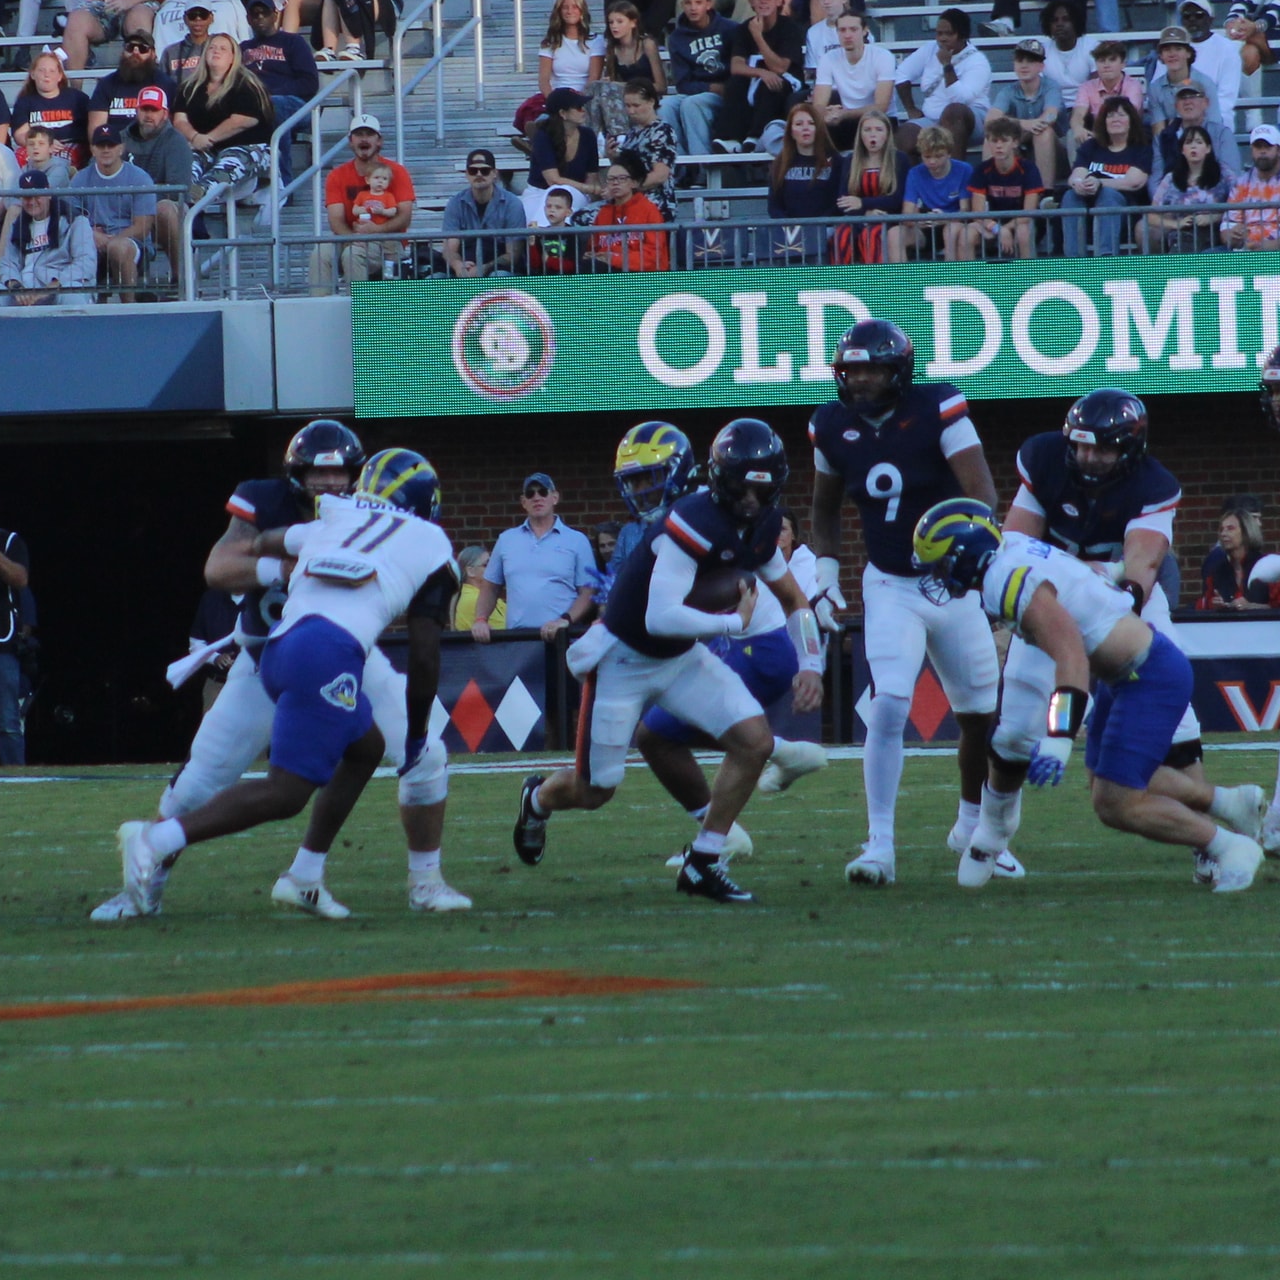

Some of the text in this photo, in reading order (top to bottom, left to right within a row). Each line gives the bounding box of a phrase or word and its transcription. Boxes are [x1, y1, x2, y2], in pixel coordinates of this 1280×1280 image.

[29, 109, 74, 123] UVASTRONG
[638, 288, 872, 388] OLD
[865, 462, 904, 522] 9
[340, 512, 409, 554] 11
